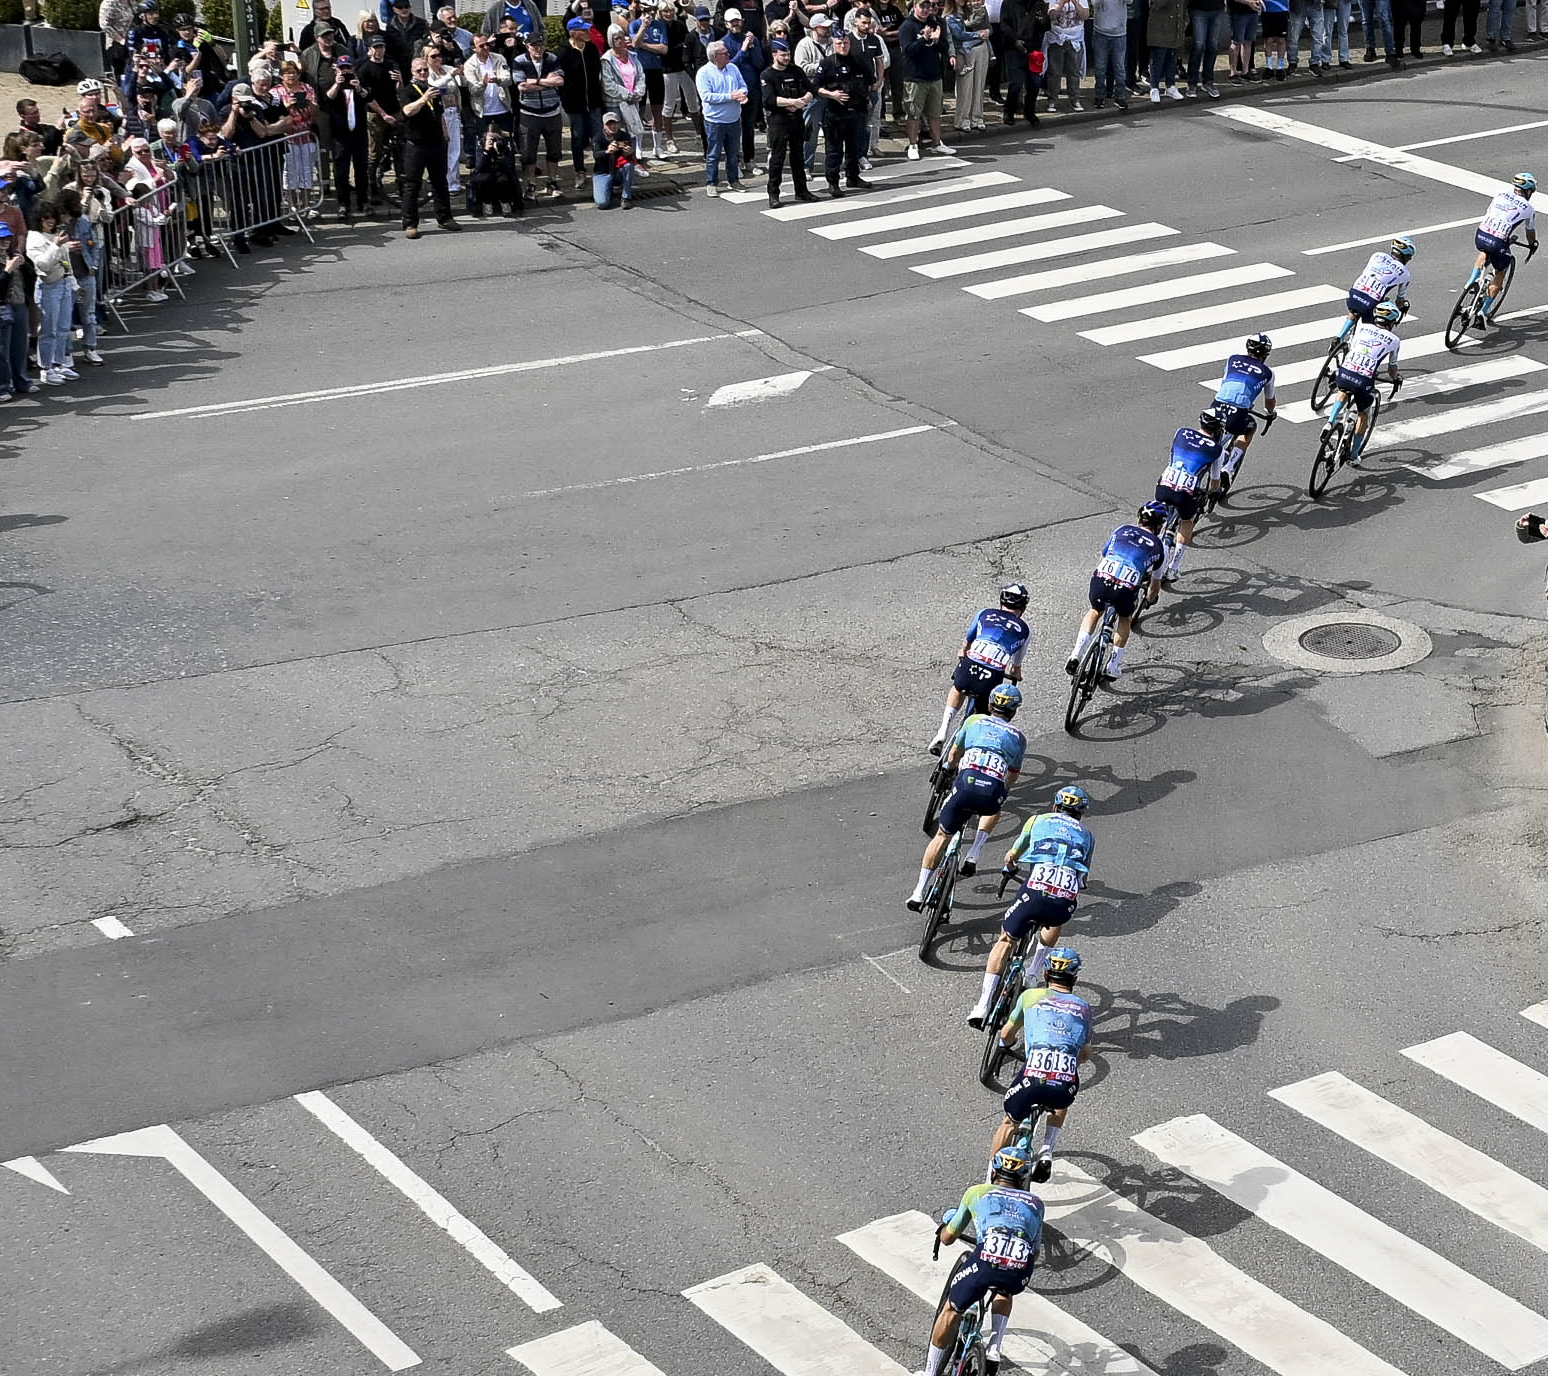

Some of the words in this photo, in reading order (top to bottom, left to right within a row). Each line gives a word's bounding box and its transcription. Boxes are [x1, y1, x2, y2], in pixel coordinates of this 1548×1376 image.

[1182, 474, 1194, 488] 73
[1101, 559, 1114, 573] 76
[1125, 567, 1137, 584] 76
[986, 755, 1006, 773] 135
[1027, 1052, 1052, 1071] 136
[1055, 1054, 1077, 1074] 136
